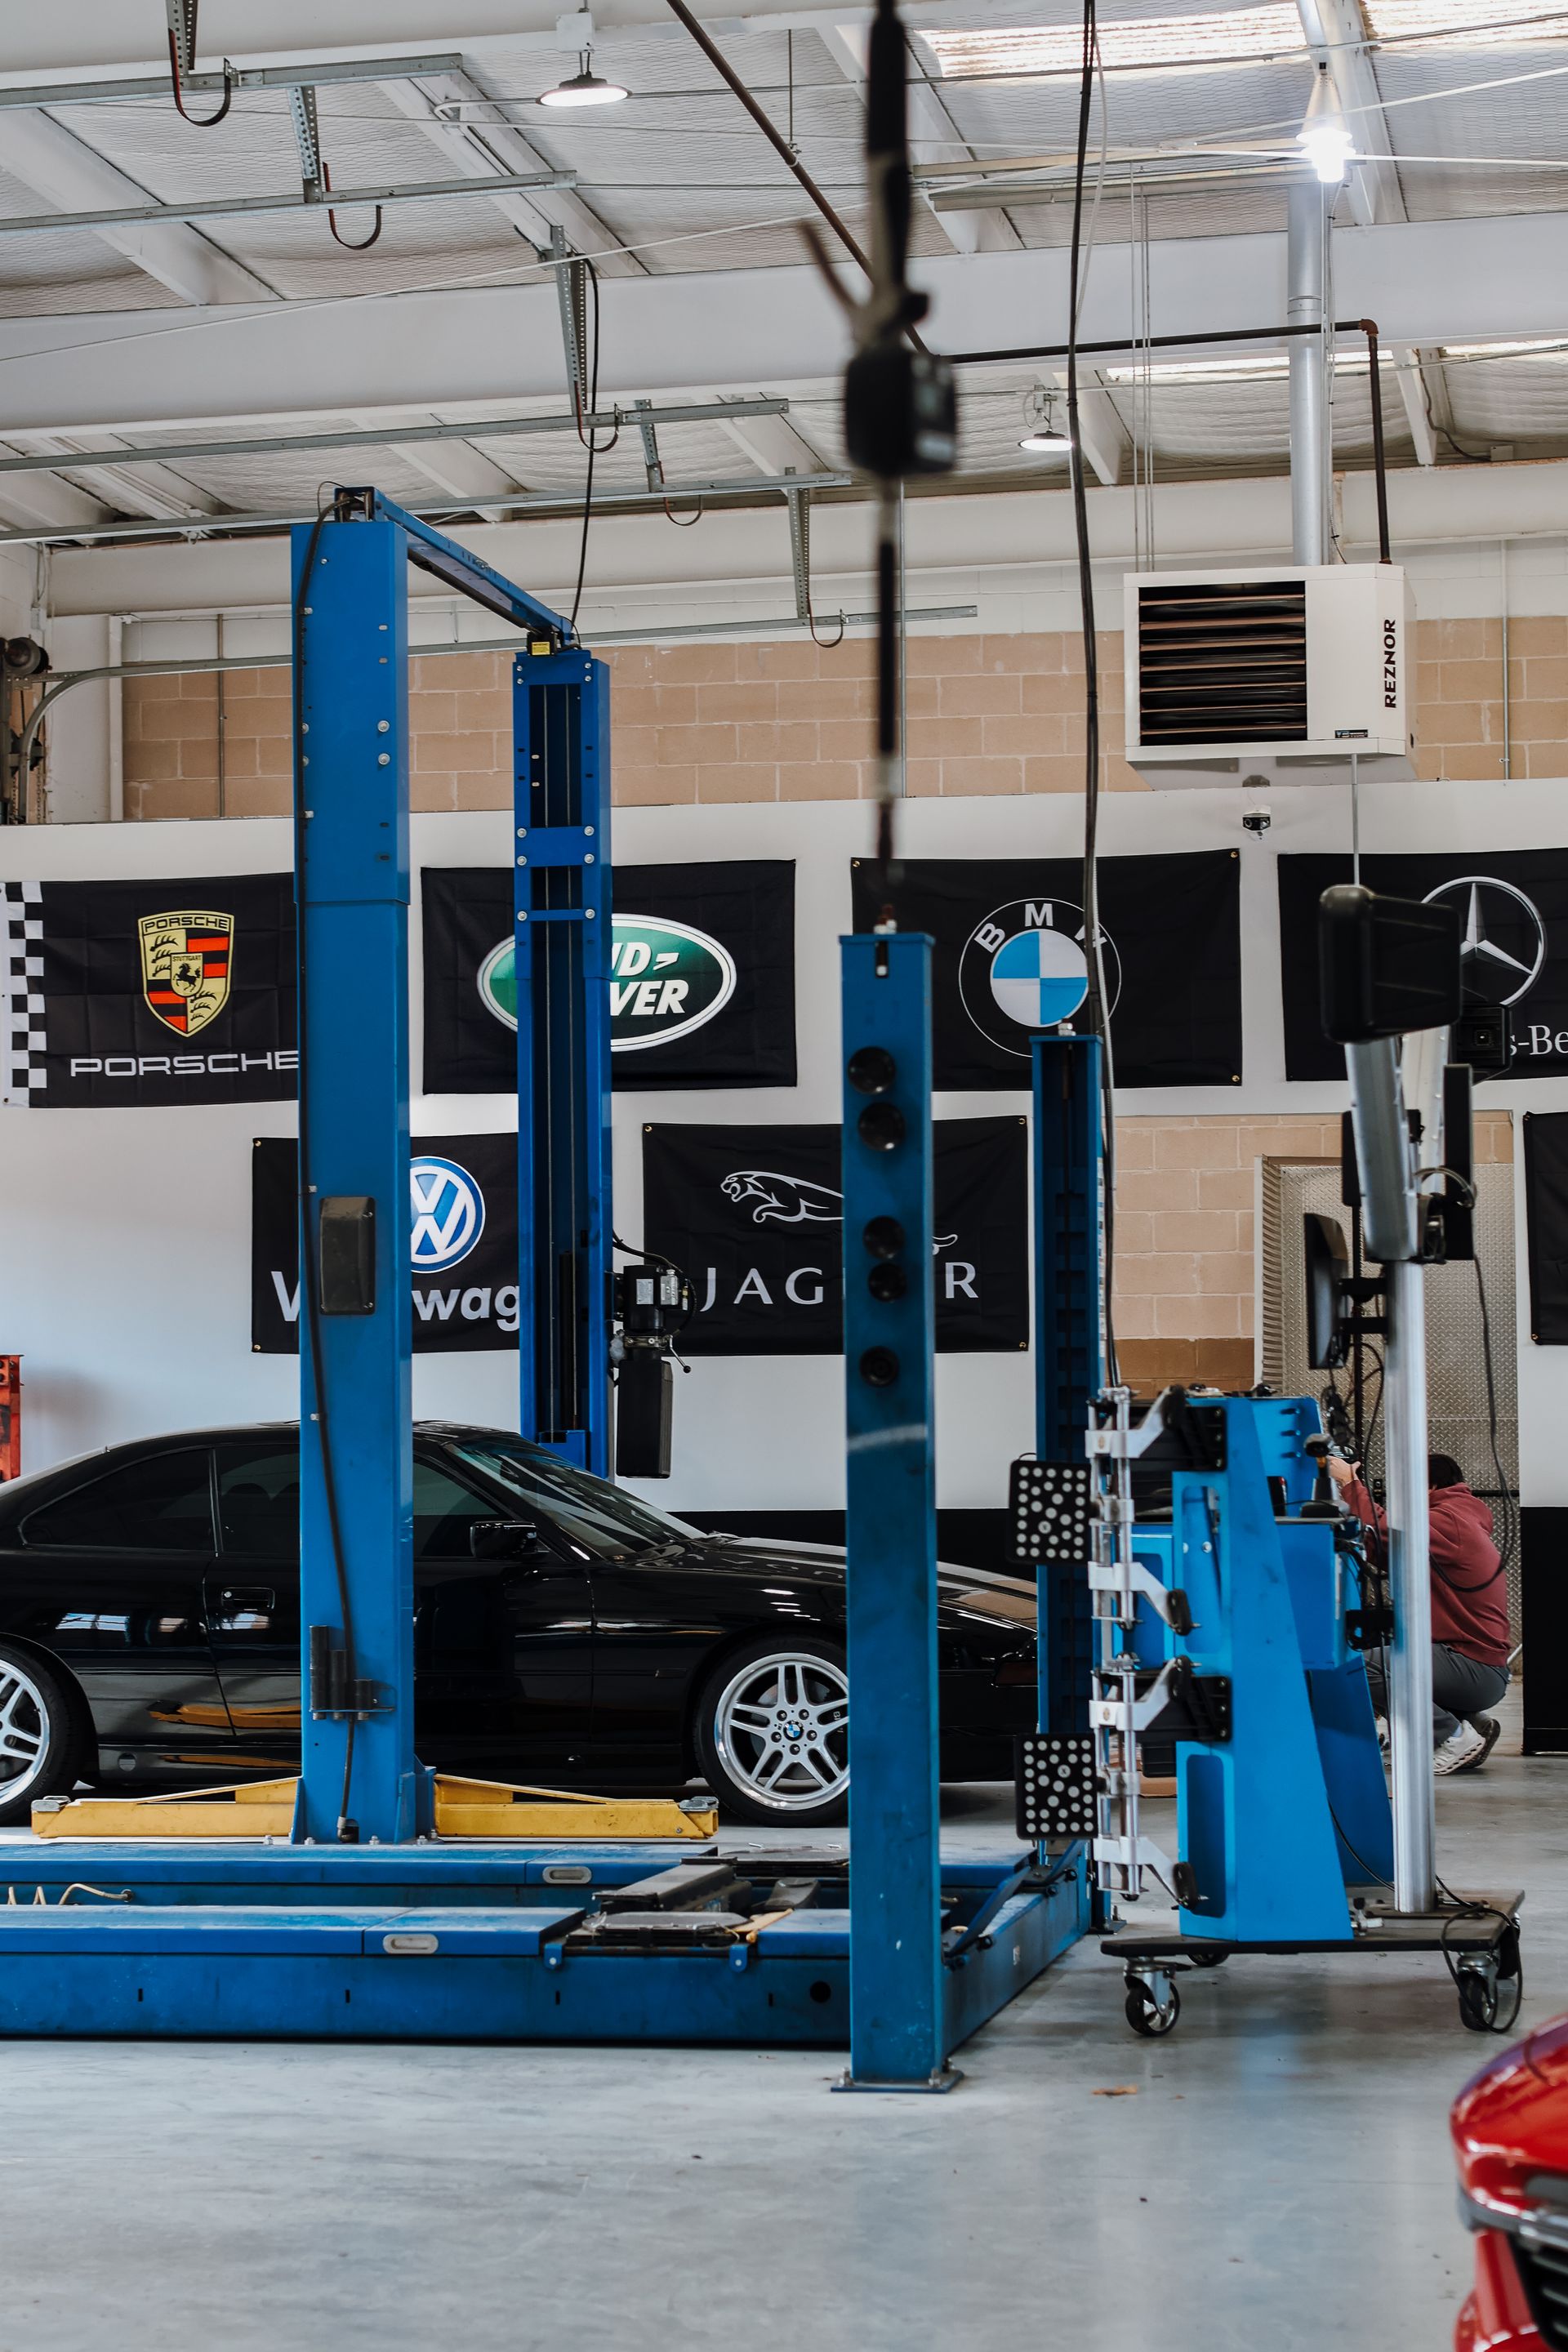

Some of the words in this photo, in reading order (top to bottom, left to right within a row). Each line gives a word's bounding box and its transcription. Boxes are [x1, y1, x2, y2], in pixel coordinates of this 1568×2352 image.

[1383, 619, 1396, 709] REZNOR
[145, 916, 228, 933] PORSCHE
[70, 1050, 300, 1076] PORSCHE
[700, 1262, 978, 1312] JAGR
